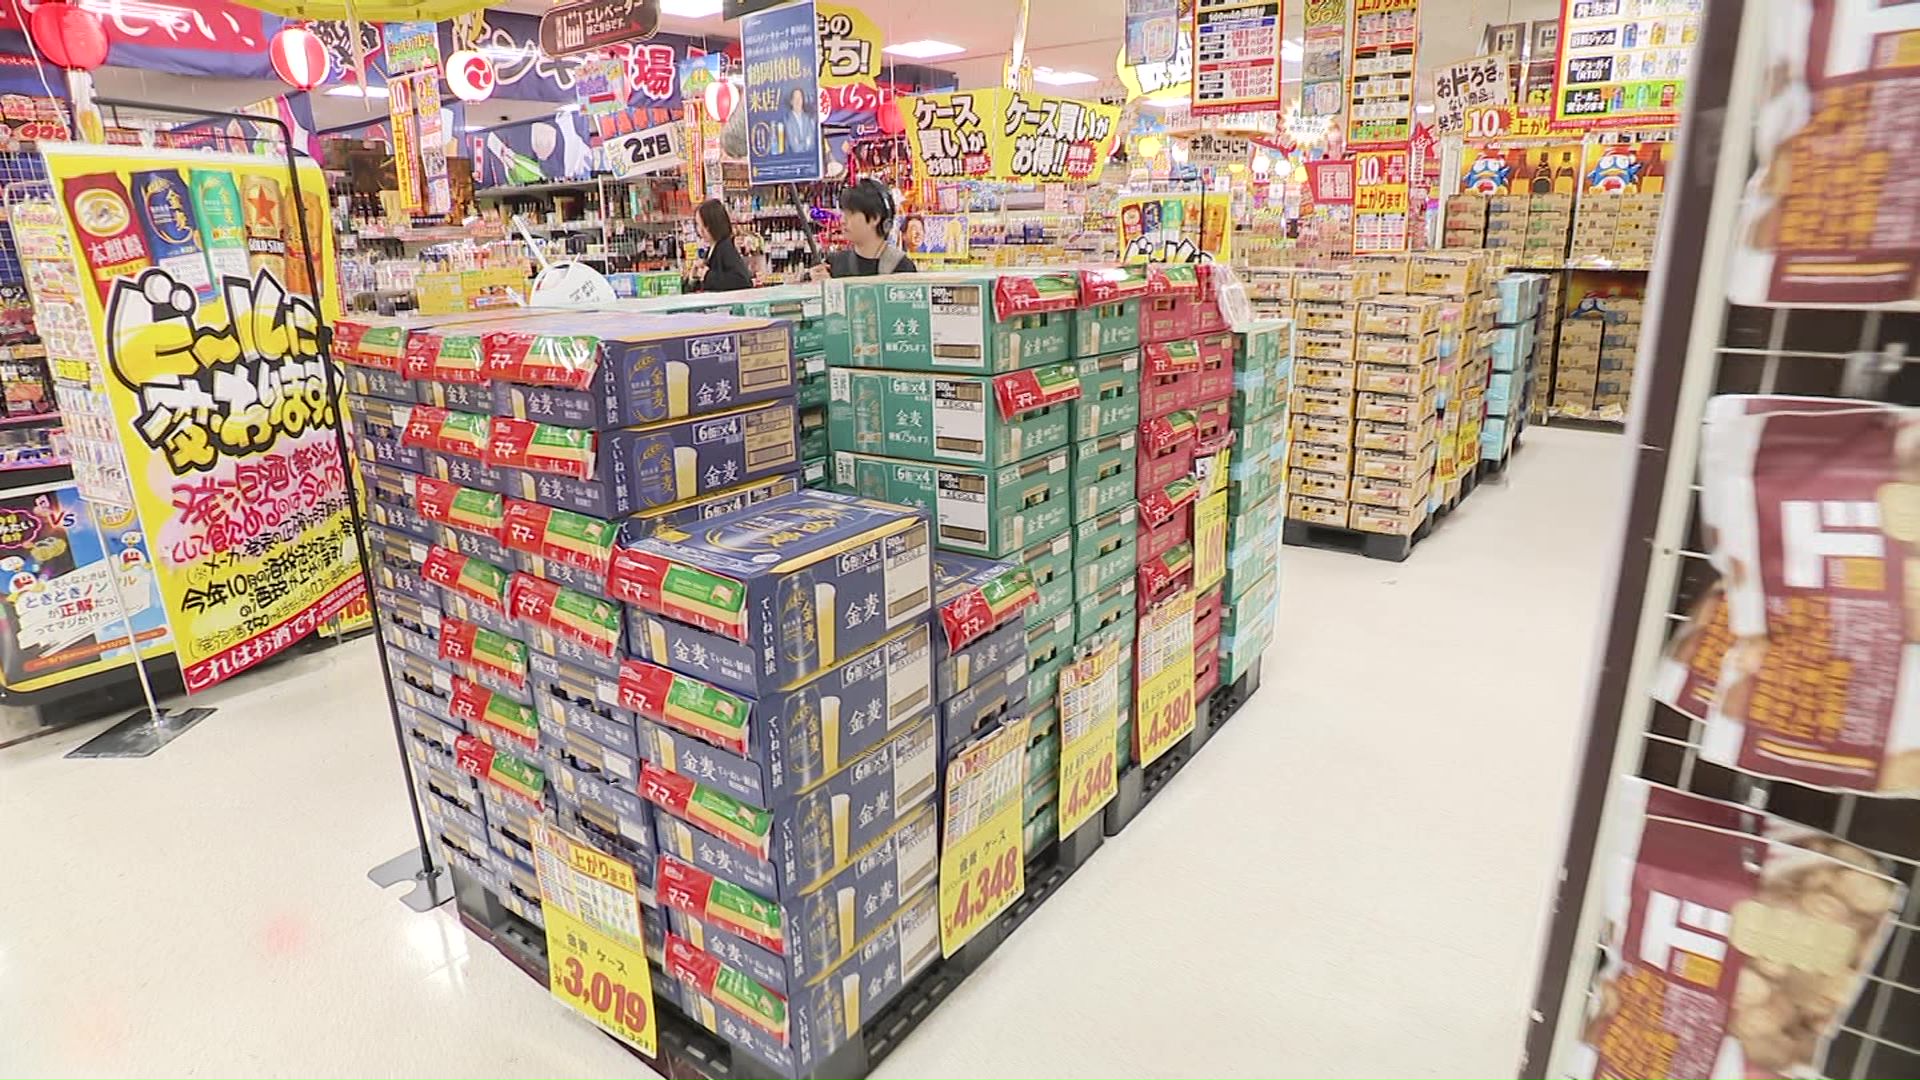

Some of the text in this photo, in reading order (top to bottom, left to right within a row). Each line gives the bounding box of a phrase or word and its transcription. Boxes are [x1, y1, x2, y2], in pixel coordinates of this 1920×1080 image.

[915, 95, 980, 131] ケース
[1005, 93, 1110, 143] ケース買いが
[624, 133, 671, 163] 2丁目
[919, 129, 988, 161] 買いが
[1012, 136, 1068, 177] お得!!
[1357, 187, 1406, 209] 上がります!
[109, 268, 322, 391] ビールに
[892, 318, 920, 337] 金麦
[447, 385, 469, 405] 金麦
[528, 391, 554, 416] 金麦
[696, 378, 732, 406] 金麦
[896, 409, 923, 428] 金麦
[539, 478, 566, 501] 金麦
[703, 459, 739, 488] 金麦
[51, 512, 75, 529] VS
[458, 533, 482, 556] 金麦
[844, 592, 880, 630] 金麦
[189, 605, 323, 690] これはお酒です。
[673, 637, 710, 671] 金麦
[849, 697, 884, 737] 金麦
[681, 750, 718, 783] 金麦
[858, 790, 890, 830] 金麦
[699, 841, 734, 875] 金麦
[864, 879, 895, 918] 金麦
[954, 847, 1018, 929] 4,348
[564, 957, 648, 1033] 3,019
[868, 961, 898, 1002] 金麦
